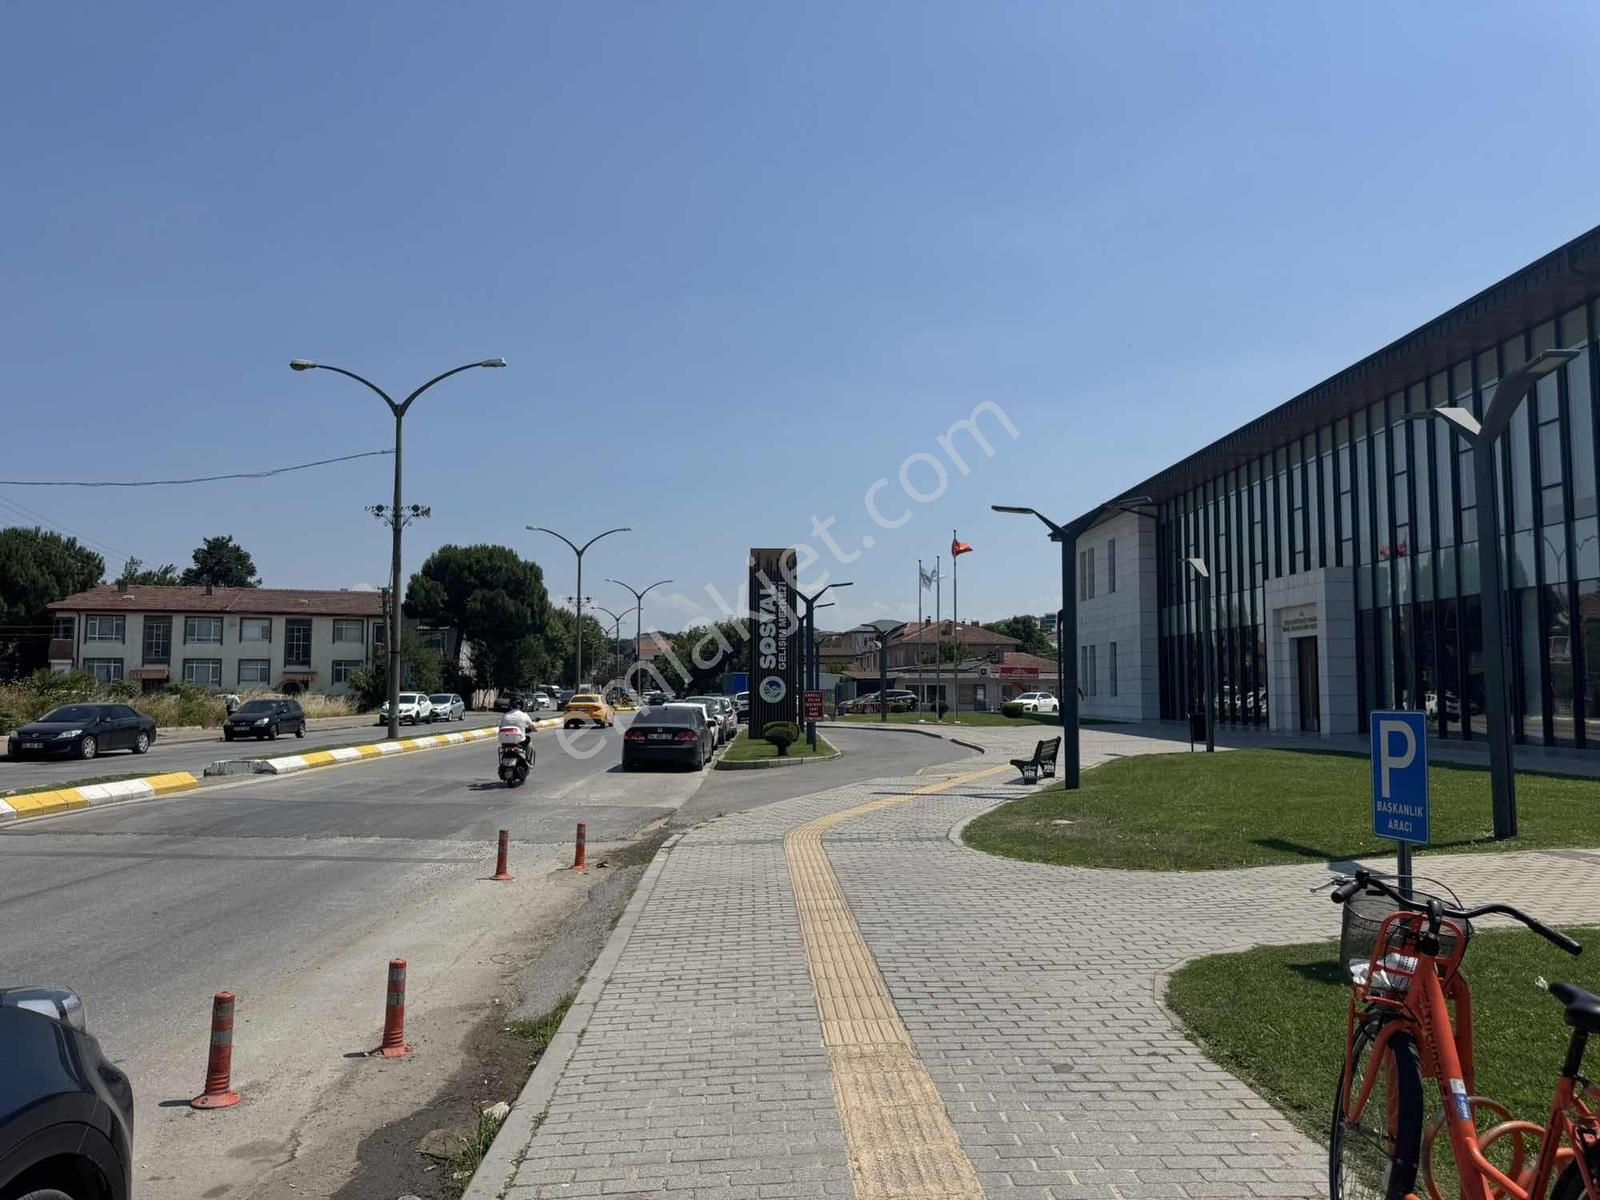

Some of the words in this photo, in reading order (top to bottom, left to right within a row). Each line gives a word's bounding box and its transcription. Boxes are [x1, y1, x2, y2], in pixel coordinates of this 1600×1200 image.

[760, 583, 777, 669] SOSYAL
[1380, 720, 1416, 798] P
[1388, 819, 1413, 832] ARACI
